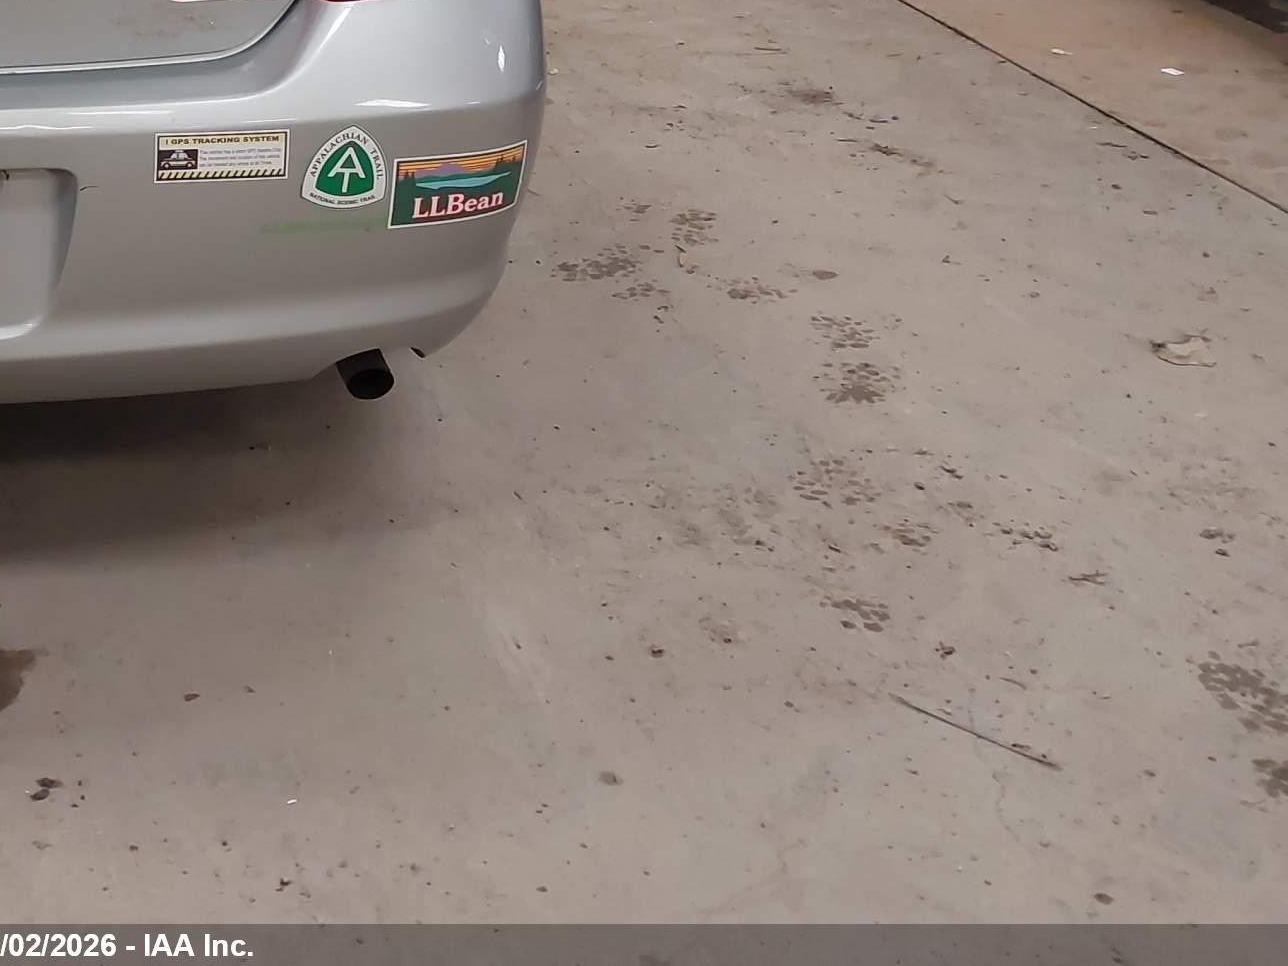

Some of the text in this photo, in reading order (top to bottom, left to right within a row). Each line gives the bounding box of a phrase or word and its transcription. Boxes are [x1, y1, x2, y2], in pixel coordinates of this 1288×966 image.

[171, 137, 190, 146] GPS
[192, 136, 240, 144] TRACKING
[243, 135, 280, 143] SYSTEM
[310, 132, 384, 180] APPALACHIAN TRAIL
